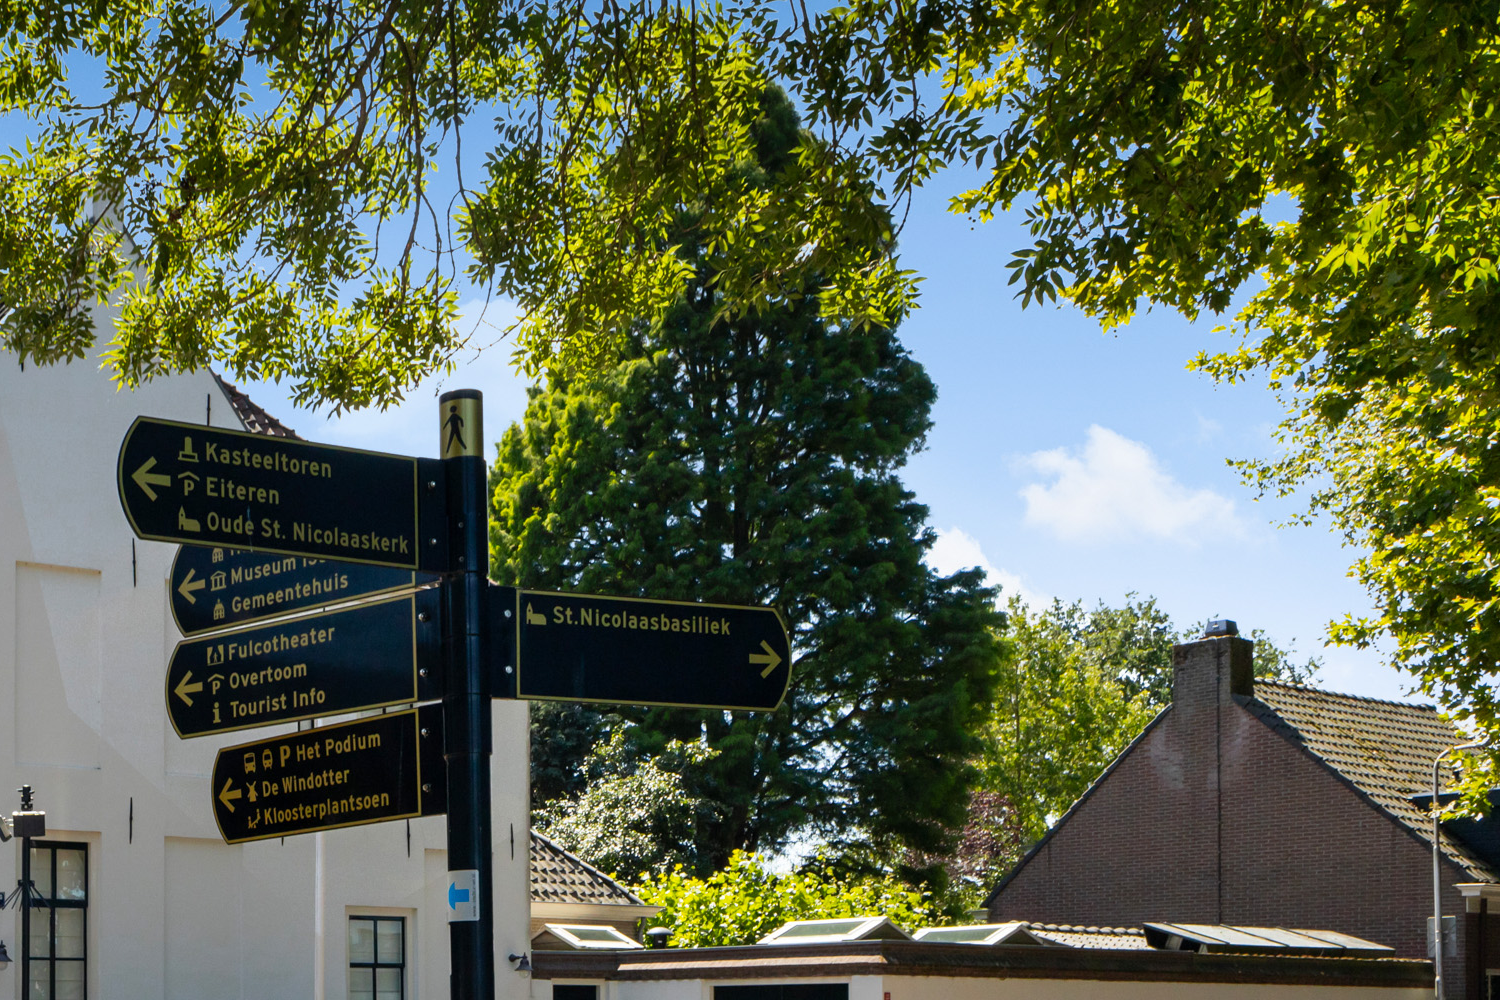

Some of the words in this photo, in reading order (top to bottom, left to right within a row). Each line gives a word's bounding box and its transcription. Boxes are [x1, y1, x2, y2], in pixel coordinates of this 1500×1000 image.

[206, 442, 332, 478] Kasteeltoren
[206, 477, 279, 504] Eiteren
[207, 511, 254, 535] Oude
[261, 518, 286, 539] St.
[293, 522, 408, 554] Nicolaaskerk
[231, 557, 296, 585] Museum
[232, 573, 348, 613] Gemeentehuis
[553, 606, 731, 635] St.Nicolaasbasiliek
[229, 627, 335, 660] Fulcotheater
[229, 663, 307, 689] Overtoom
[230, 696, 287, 718] Tourist
[293, 688, 326, 707] Info
[297, 742, 320, 762] Het
[326, 732, 381, 756] Podium
[262, 780, 278, 797] De
[282, 769, 350, 794] Windotter
[264, 792, 389, 825] Kloosterplantsoen
